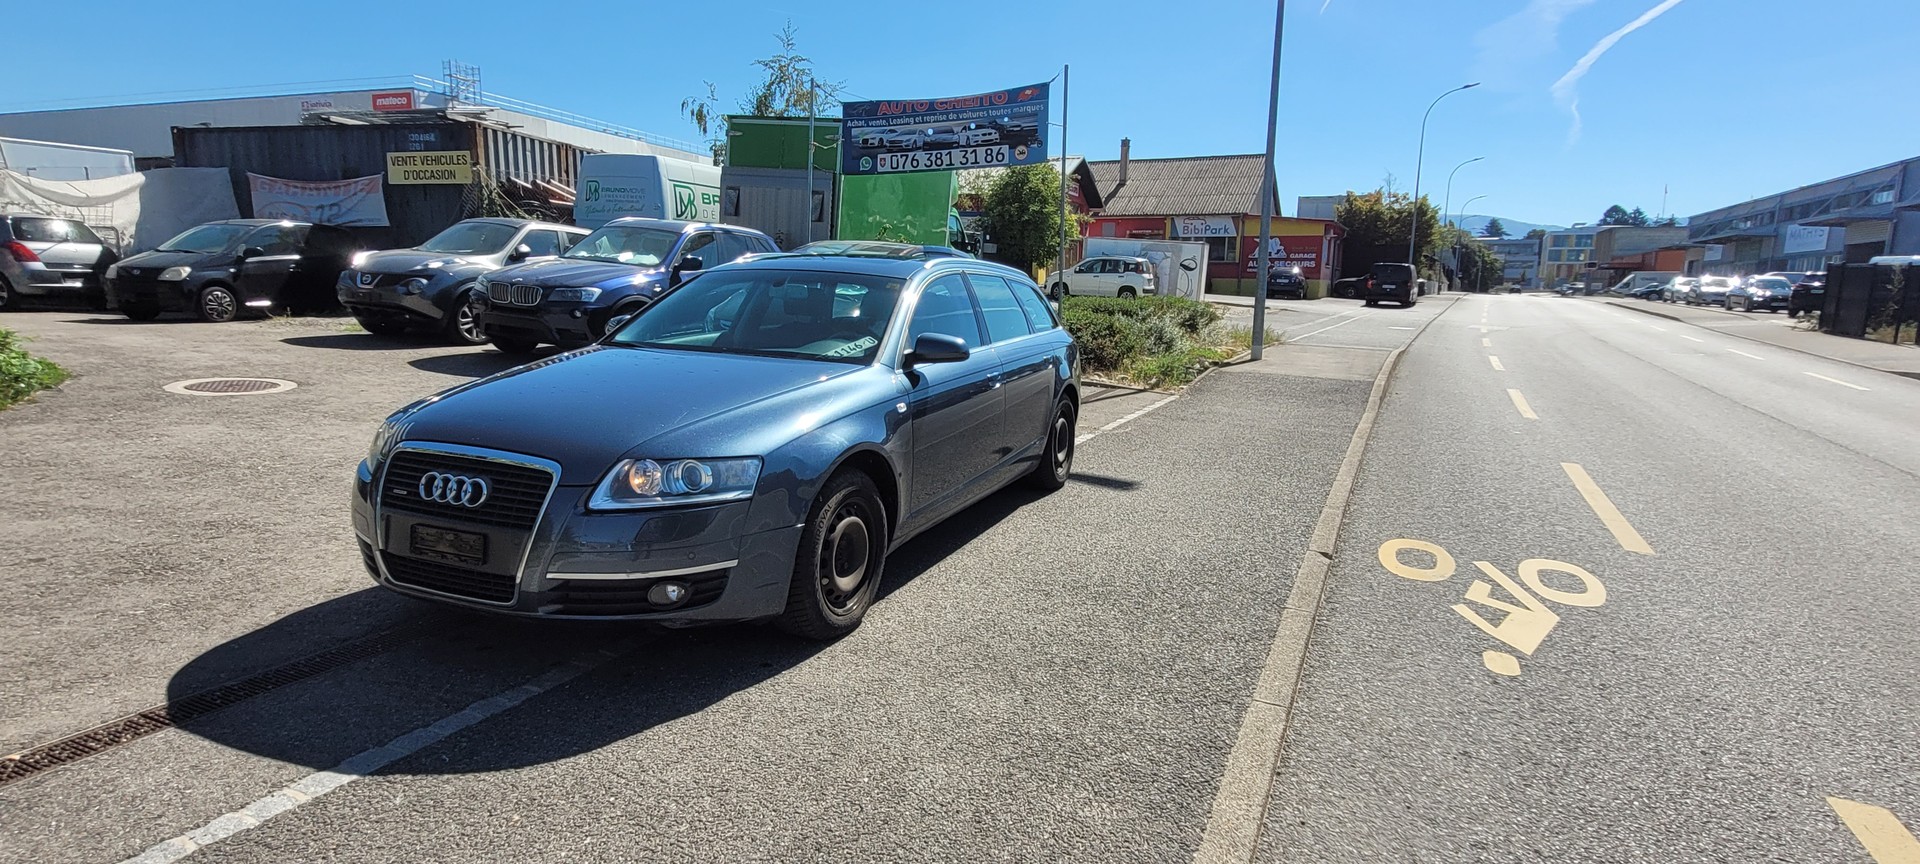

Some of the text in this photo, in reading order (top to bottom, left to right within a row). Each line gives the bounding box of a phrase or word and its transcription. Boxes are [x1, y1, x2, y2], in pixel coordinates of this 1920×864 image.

[376, 96, 408, 106] mateco
[877, 100, 929, 116] AUTO
[847, 104, 1044, 128] Achat, vente, Leasing et reprise de voitures toutes marques
[391, 155, 468, 166] VENTE VEHICULES
[890, 147, 1005, 170] 076 381 31 86
[404, 169, 456, 180] D'OCCASION
[1182, 224, 1230, 235] BibiPark
[1247, 260, 1316, 268] AU-SECOURS
